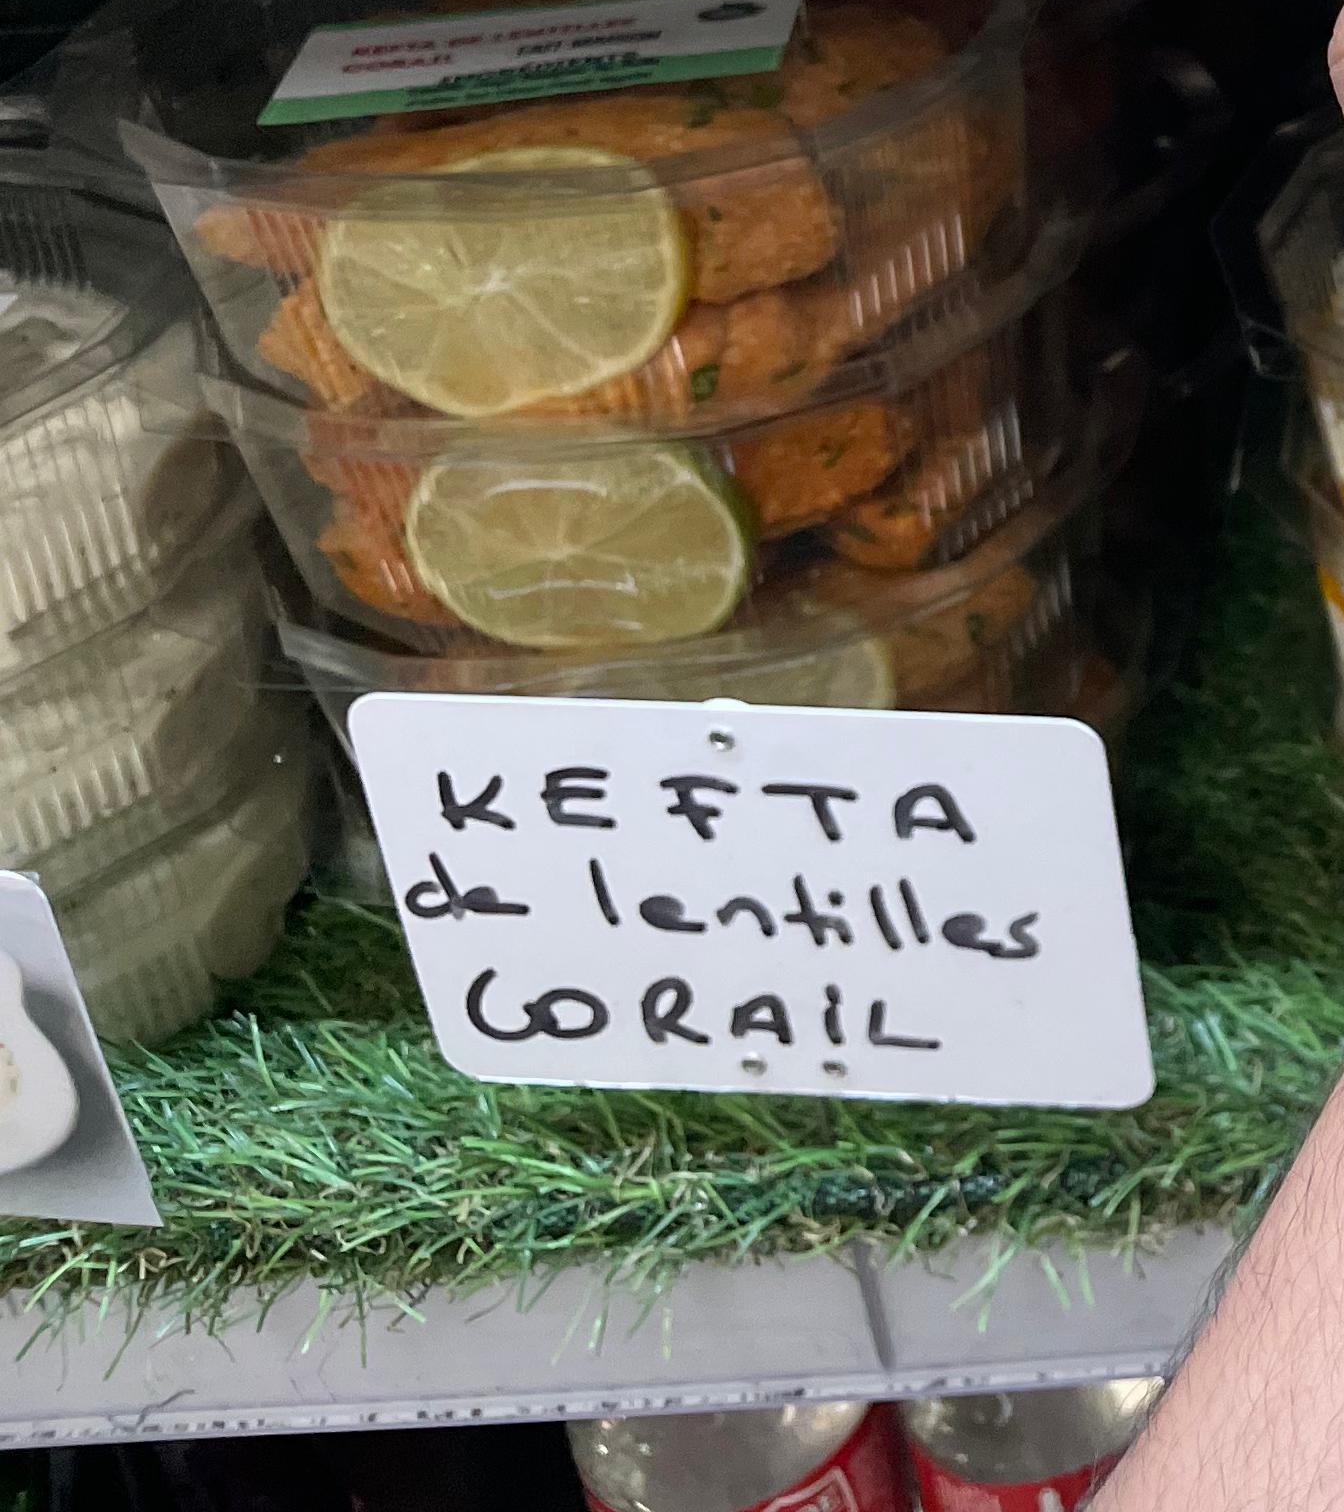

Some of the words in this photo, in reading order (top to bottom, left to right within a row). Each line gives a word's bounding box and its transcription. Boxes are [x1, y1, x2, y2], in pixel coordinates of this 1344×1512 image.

[438, 766, 978, 845] KEFTA
[405, 852, 529, 921] de
[590, 858, 1041, 959] lentilles
